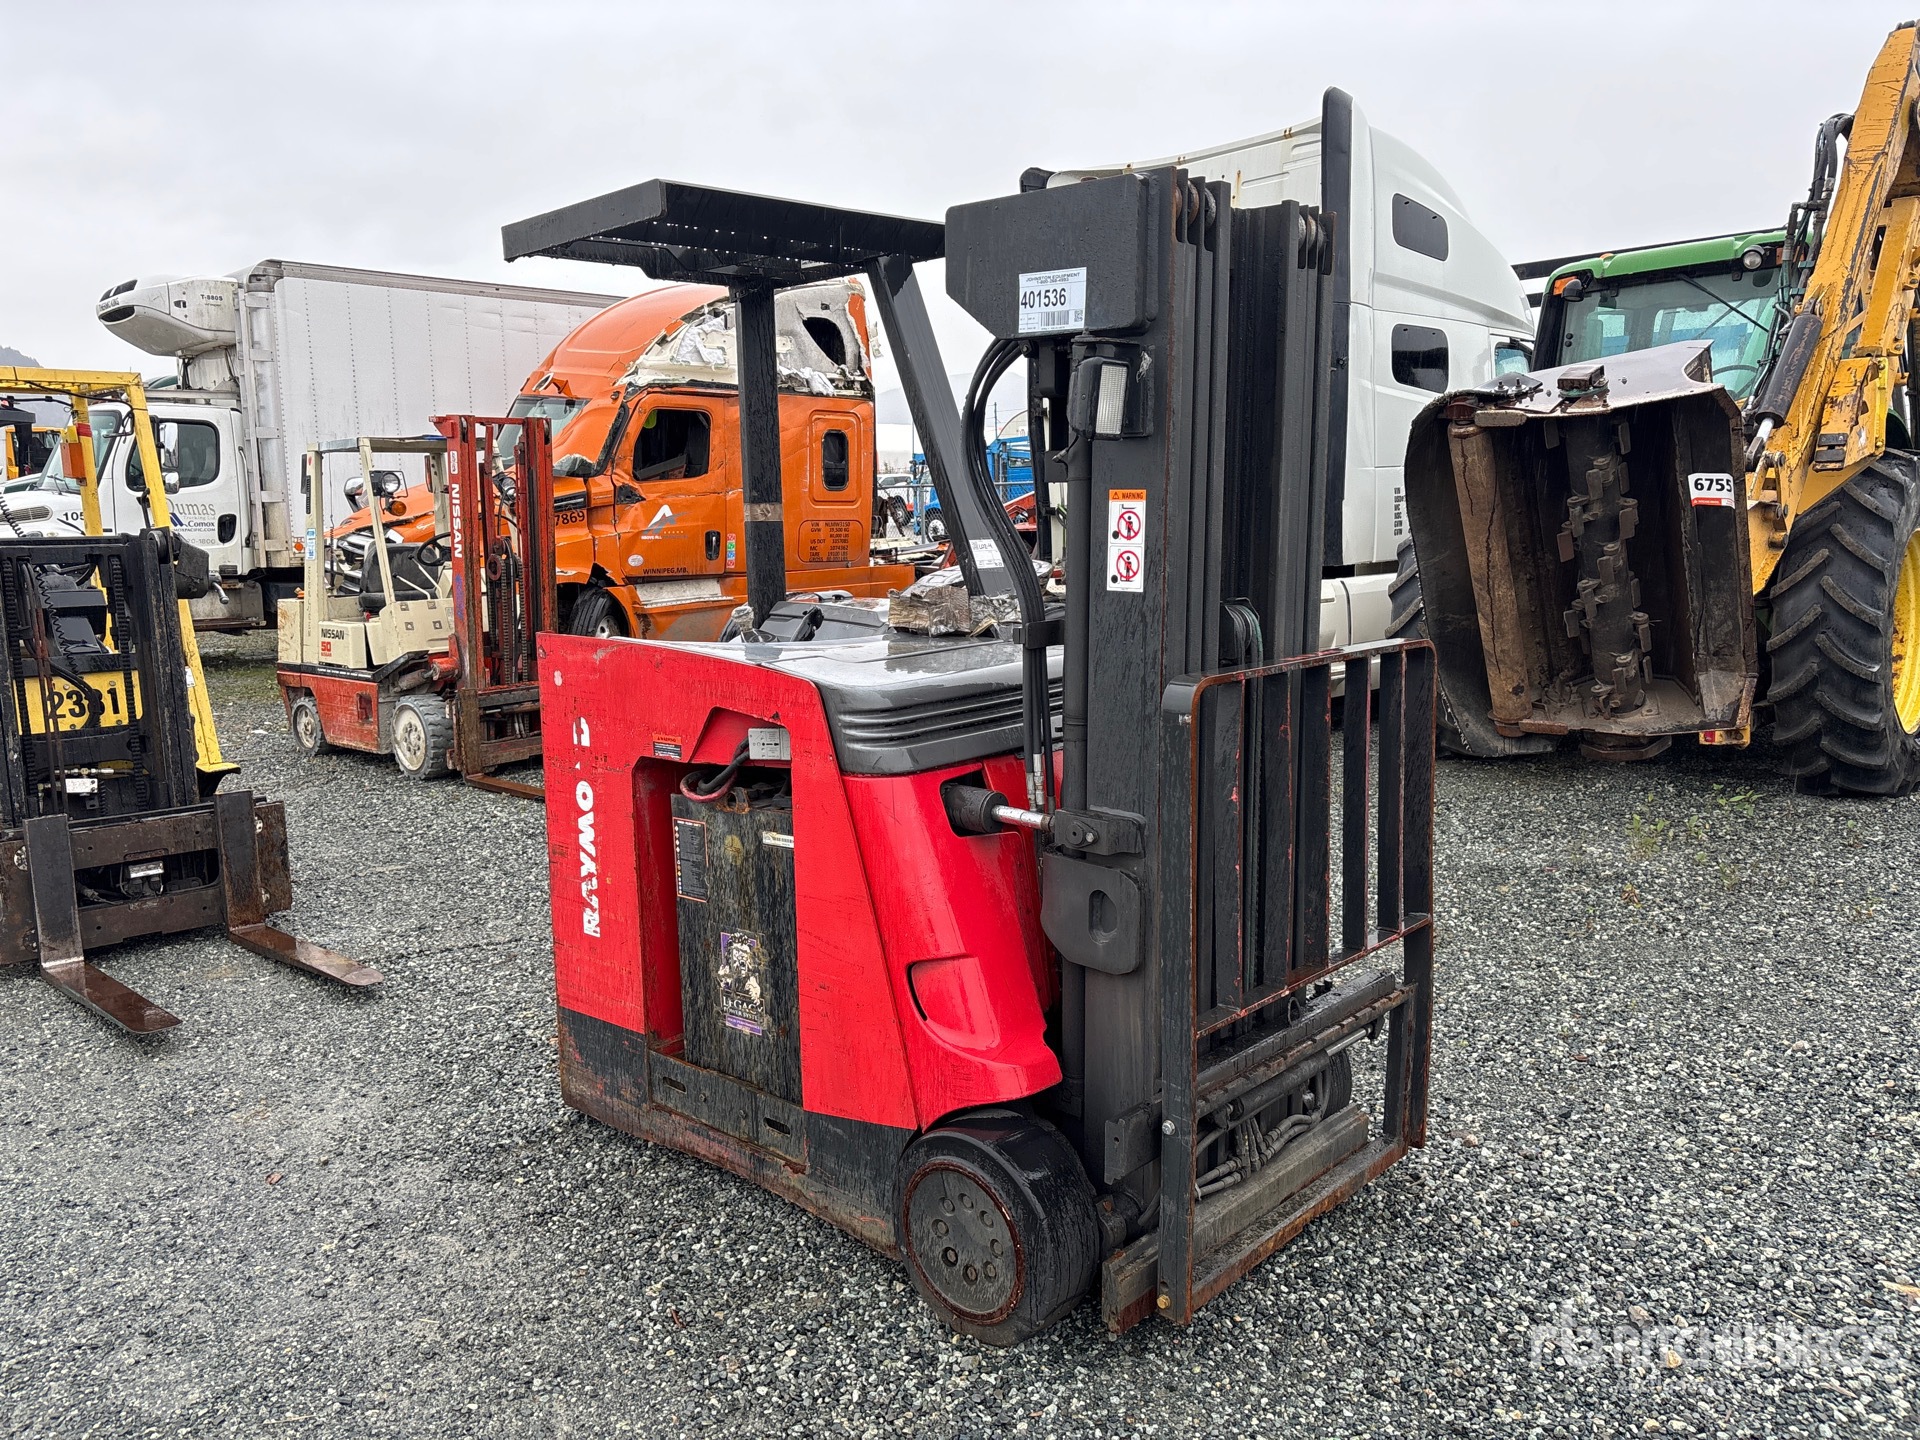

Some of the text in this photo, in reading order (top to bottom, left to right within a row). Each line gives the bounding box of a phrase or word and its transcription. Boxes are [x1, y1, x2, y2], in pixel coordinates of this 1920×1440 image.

[1021, 288, 1066, 309] 401536
[1694, 477, 1733, 493] 6755
[1121, 491, 1144, 500] WARNING
[451, 483, 463, 558] NISSAN
[554, 510, 586, 526] 7869
[321, 628, 345, 641] NISSAN
[321, 641, 332, 652] 50
[573, 717, 600, 937] RAYMOD
